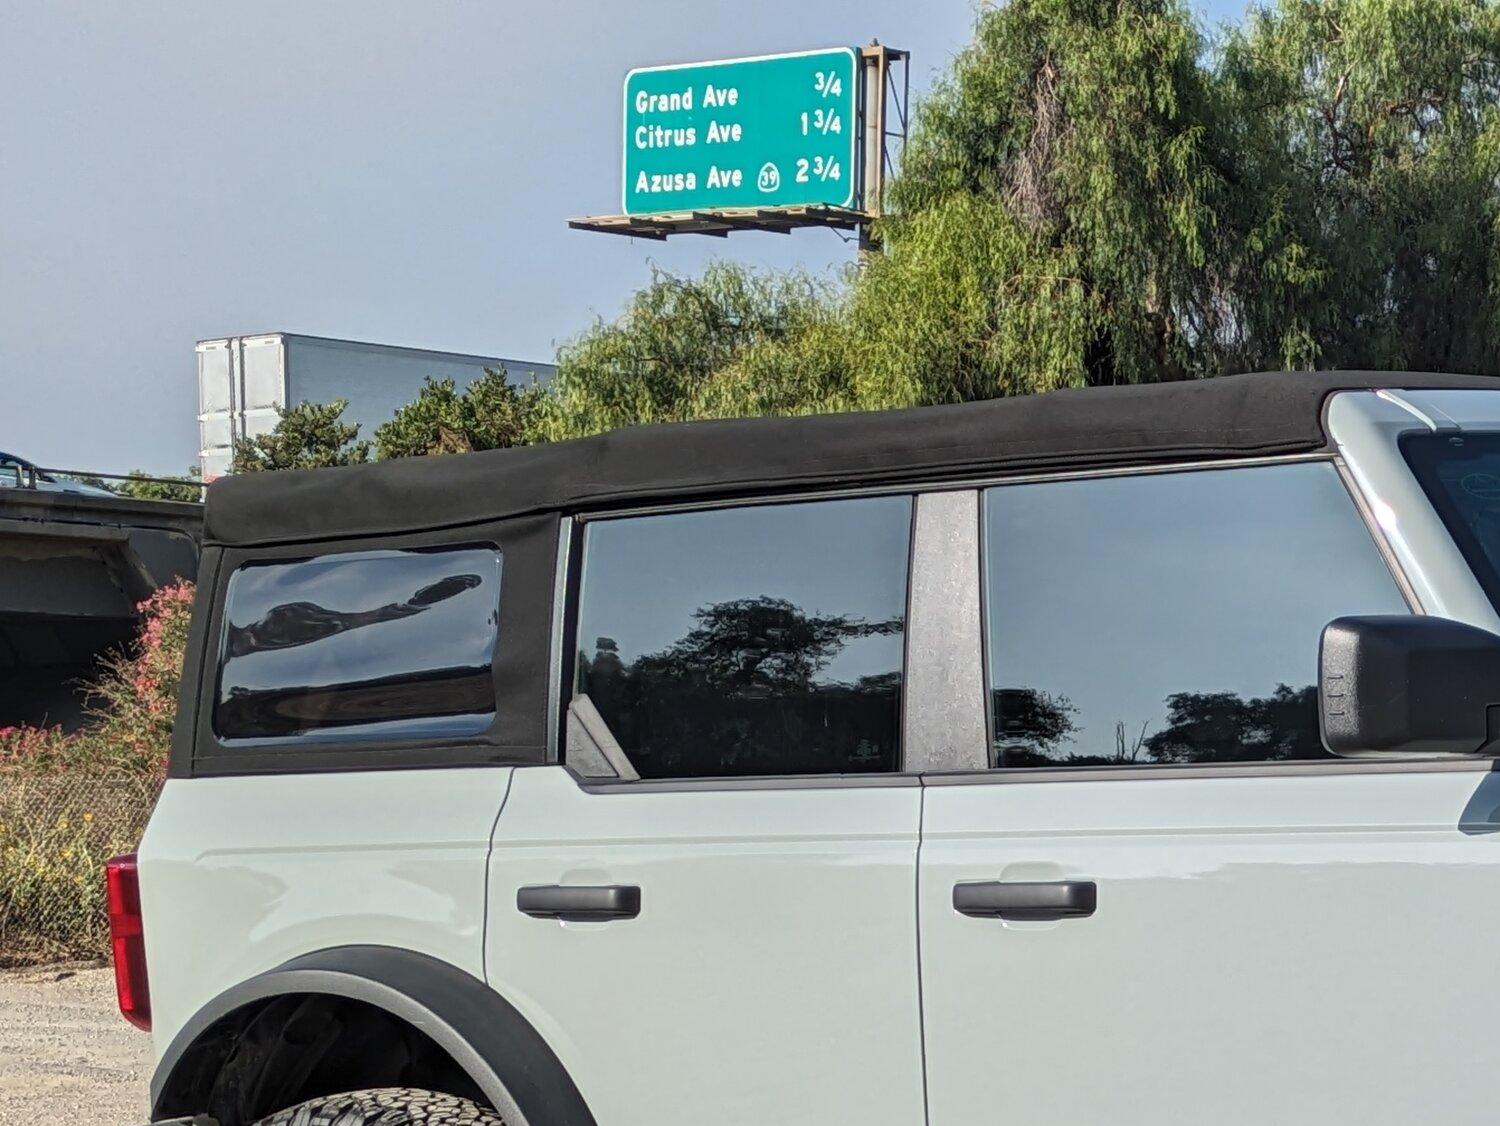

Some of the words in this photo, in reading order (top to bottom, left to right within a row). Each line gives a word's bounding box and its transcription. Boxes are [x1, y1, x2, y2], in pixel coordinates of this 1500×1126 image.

[635, 87, 693, 113] Grand
[703, 85, 738, 108] Ave
[635, 124, 696, 149] Citrus
[706, 121, 742, 144] Ave
[635, 171, 696, 193] Azusa
[706, 166, 742, 189] Ave
[761, 169, 777, 186] 39
